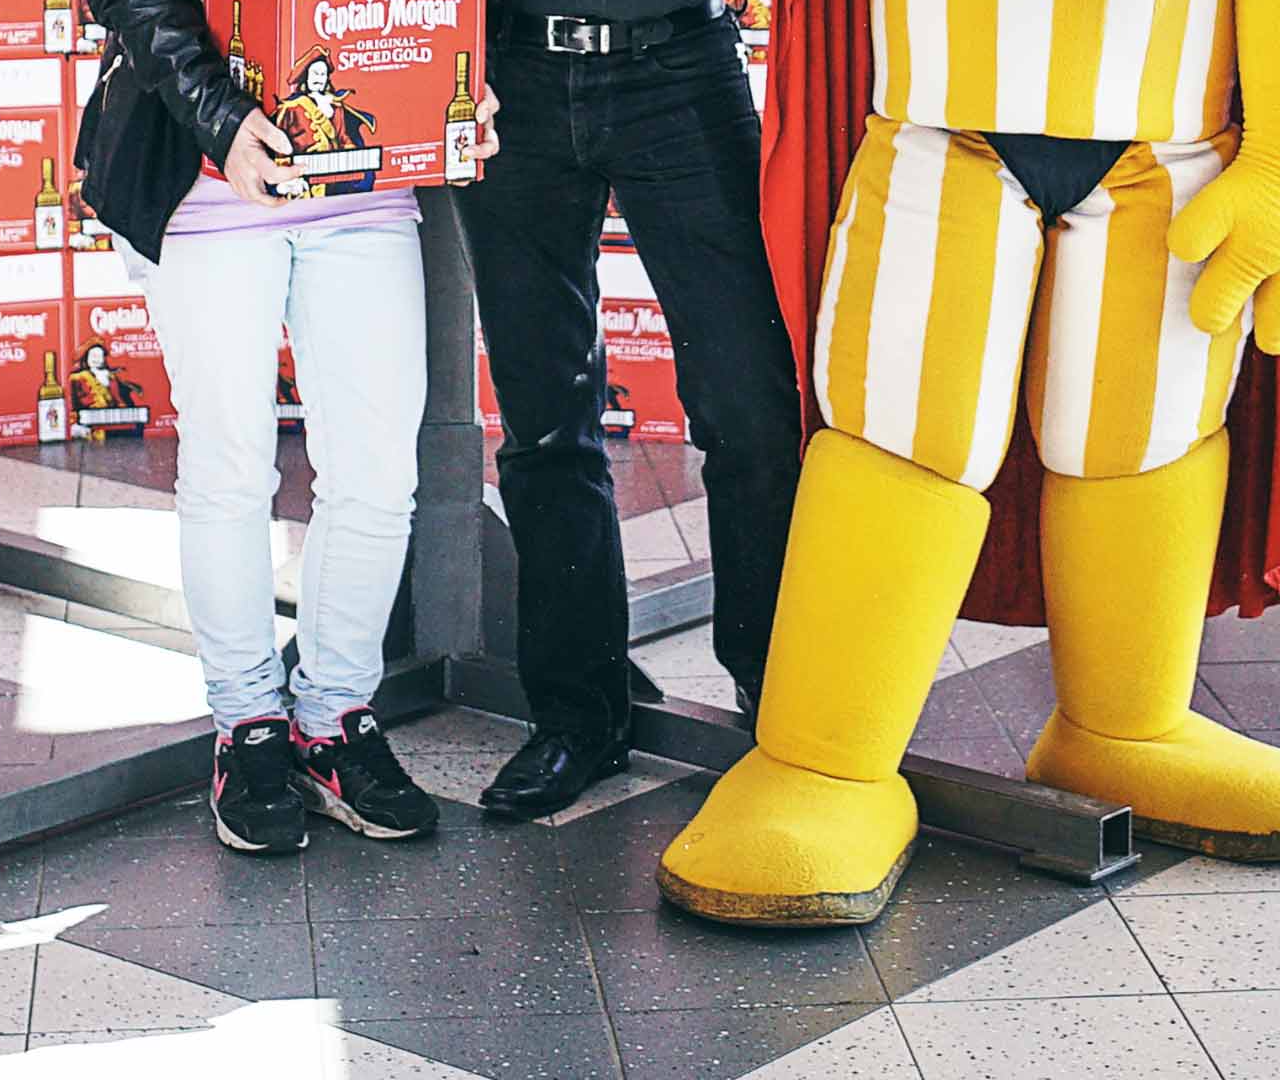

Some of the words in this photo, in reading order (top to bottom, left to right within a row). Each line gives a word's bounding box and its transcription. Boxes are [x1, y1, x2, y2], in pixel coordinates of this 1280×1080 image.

[357, 37, 416, 50] ORIGINAL
[338, 49, 391, 71] SPICED
[392, 47, 432, 64] GOLD
[90, 305, 148, 334] Captain
